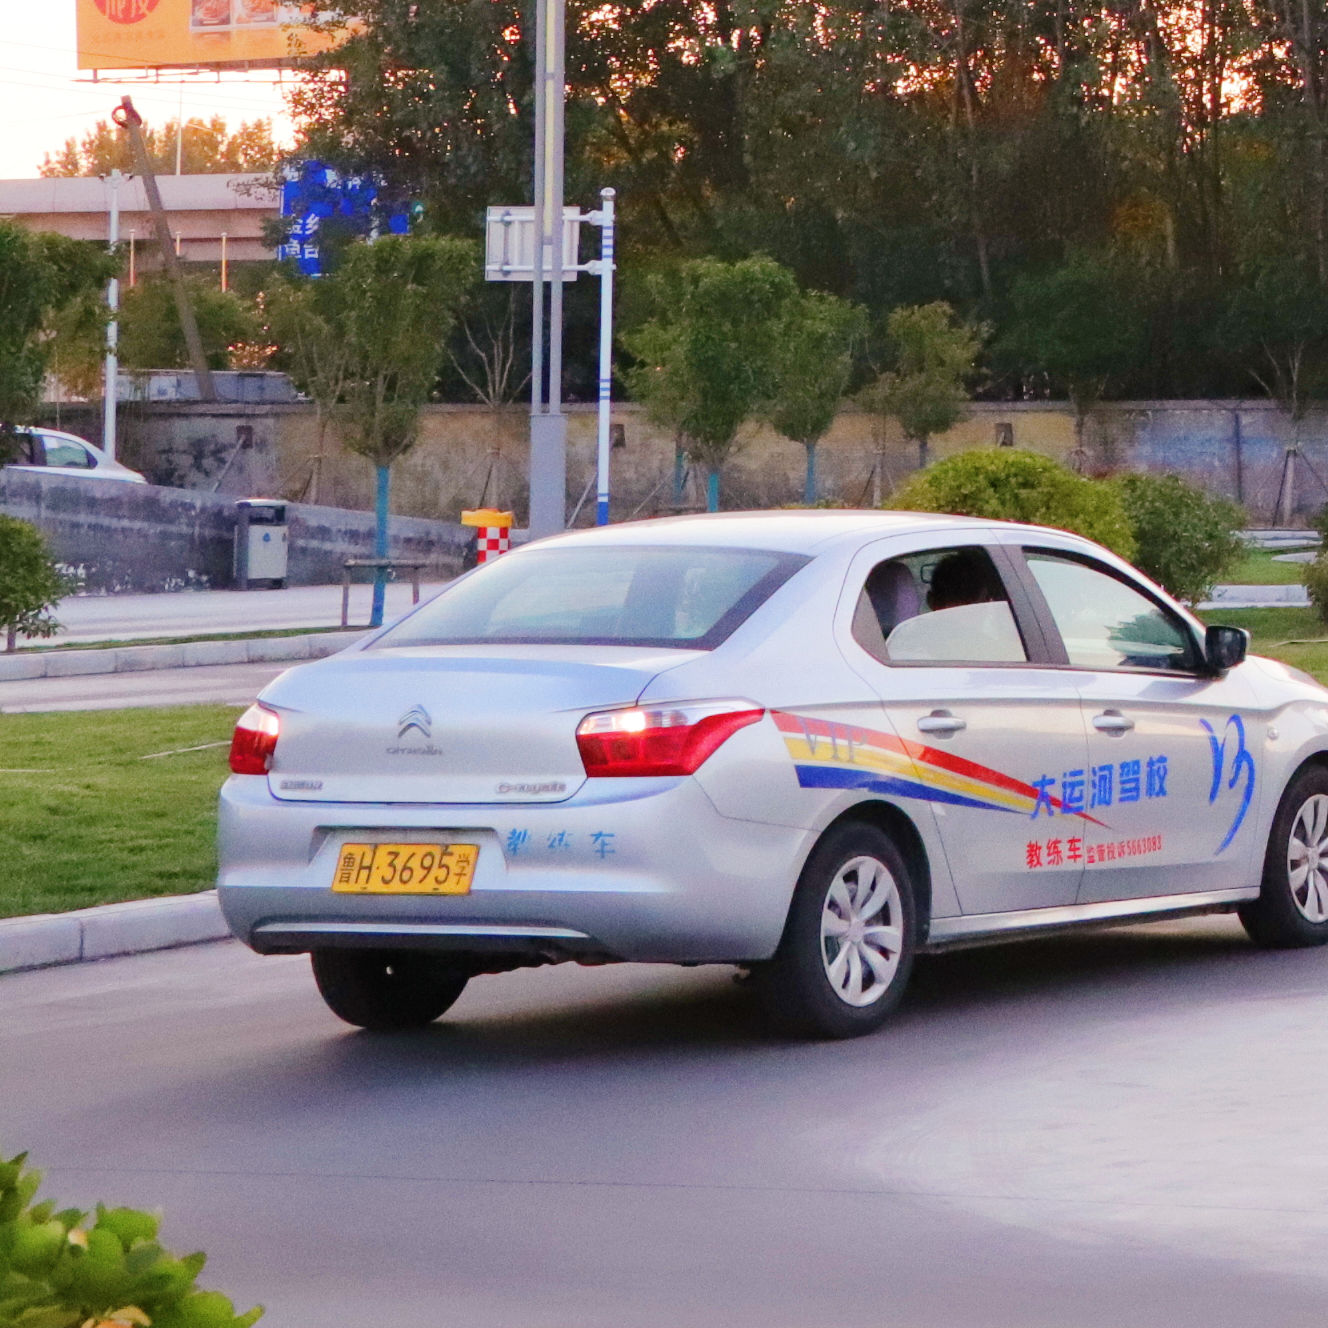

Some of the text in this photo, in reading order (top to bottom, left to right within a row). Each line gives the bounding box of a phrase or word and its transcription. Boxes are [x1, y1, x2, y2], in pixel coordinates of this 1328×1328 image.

[796, 716, 868, 761] VIP
[1030, 755, 1168, 820] 大运河驾校
[1026, 836, 1083, 869] 教练车
